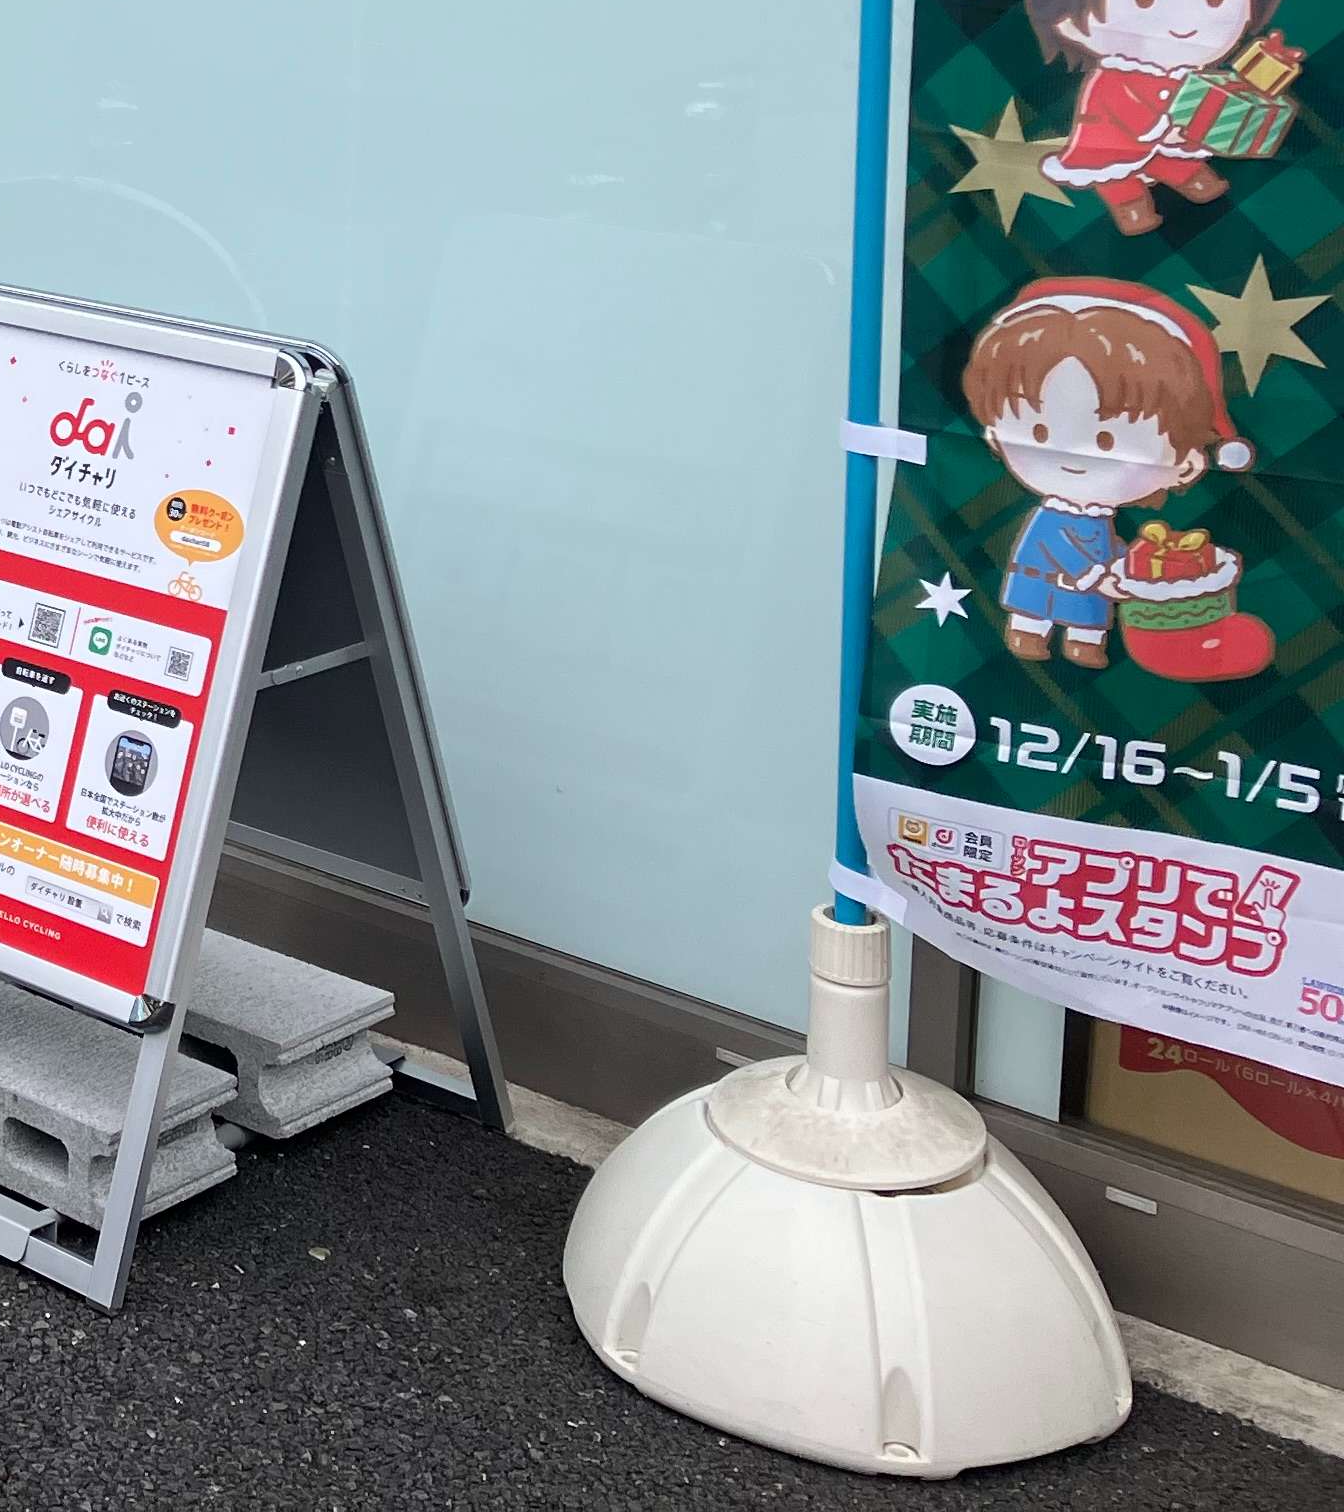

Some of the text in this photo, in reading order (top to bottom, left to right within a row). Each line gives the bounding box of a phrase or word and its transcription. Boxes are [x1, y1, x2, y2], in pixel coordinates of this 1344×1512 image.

[58, 360, 150, 388] くらしをつなぐ1ピース
[50, 391, 143, 460] dai
[50, 455, 117, 489] ダイチャリ
[19, 481, 137, 520] いつでもどこでも気軽に使える
[48, 504, 102, 528] シェアサイクル
[910, 698, 959, 730] 実施
[909, 722, 956, 754] 期間
[85, 815, 150, 848] 便利に使える
[101, 806, 141, 827] 拡大中だから
[963, 844, 994, 864] 限定
[964, 830, 994, 849] 会員
[1027, 840, 1240, 922] アプリで
[115, 912, 143, 932] で検索
[886, 842, 1289, 978] たまるよスタンプ
[22, 915, 62, 941] CYCLING
